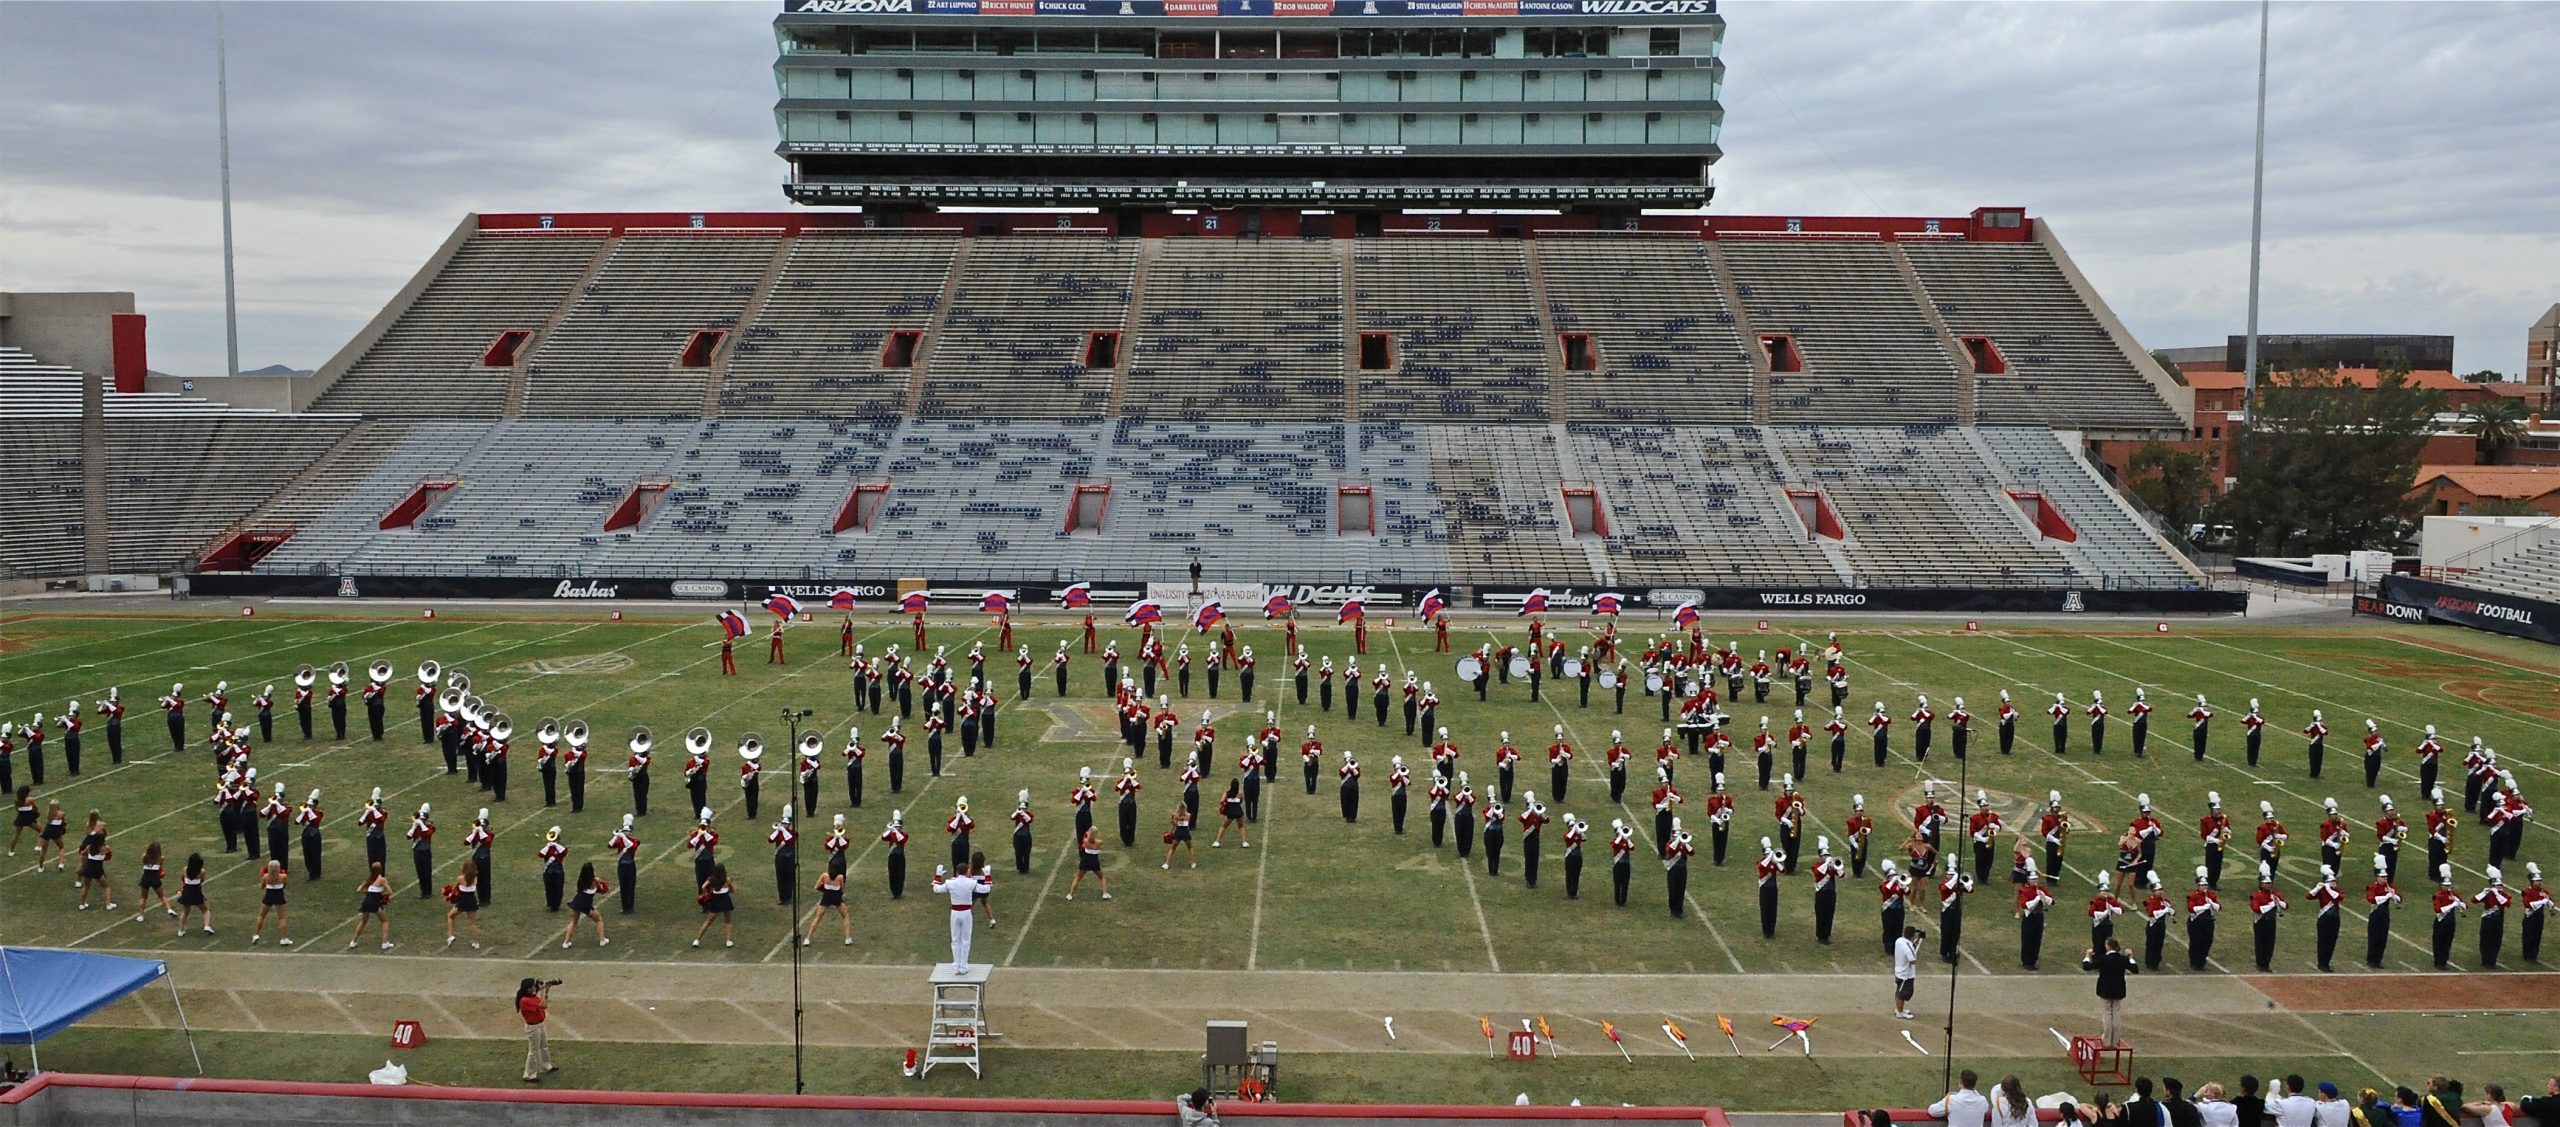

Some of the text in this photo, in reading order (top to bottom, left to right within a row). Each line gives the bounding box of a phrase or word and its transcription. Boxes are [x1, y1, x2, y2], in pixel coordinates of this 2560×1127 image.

[797, 0, 913, 13] ARIZONA
[1582, 0, 1709, 13] WILDCATS
[542, 220, 552, 229] 17
[692, 219, 703, 229] 18
[1058, 219, 1071, 229] 20
[1205, 219, 1217, 230] 21
[1428, 221, 1441, 231] 22
[1625, 222, 1638, 232] 23
[1787, 223, 1801, 233] 24
[1926, 224, 1940, 233] 25
[183, 381, 194, 390] 16
[553, 579, 618, 598] Bashas'
[781, 586, 833, 596] WELLS
[1150, 590, 1185, 599] UNIVERSITY
[1226, 590, 1245, 599] BAND
[1246, 590, 1259, 599] DAY
[1760, 593, 1866, 605] WELLS FARGO
[394, 1024, 413, 1044] 40
[1512, 1036, 1531, 1056] 40
